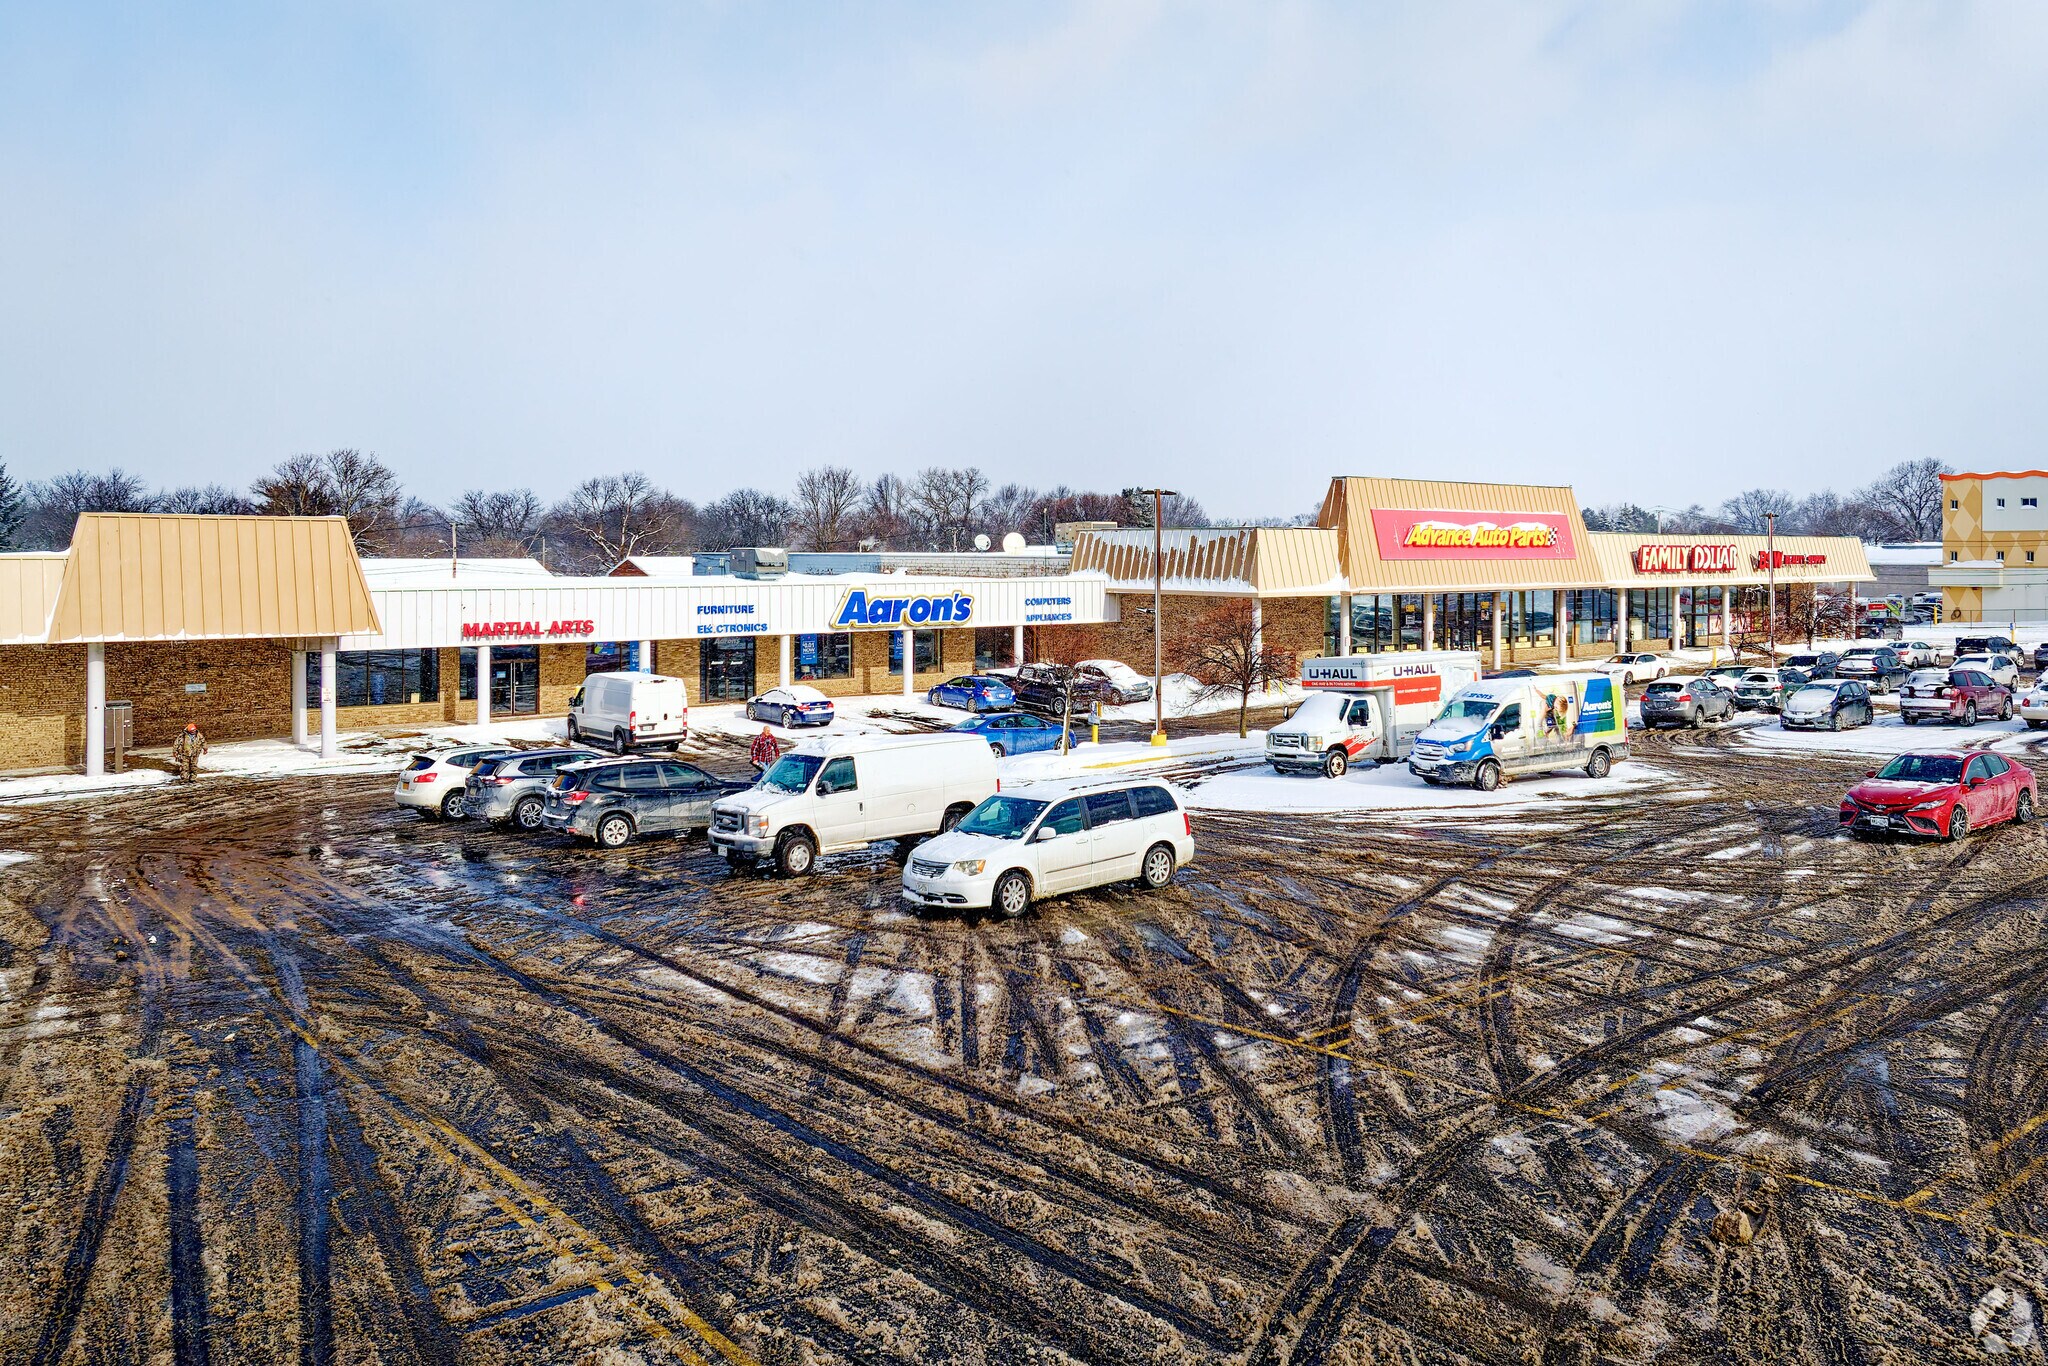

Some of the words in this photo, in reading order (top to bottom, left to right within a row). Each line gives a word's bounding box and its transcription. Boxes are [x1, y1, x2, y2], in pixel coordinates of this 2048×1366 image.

[1407, 524, 1471, 547] Advance
[1472, 525, 1510, 547] Auto
[1511, 526, 1545, 547] Parts
[1641, 545, 1690, 570] FAMILY
[1693, 545, 1738, 570] DOLLAR
[1025, 597, 1072, 606] COMPUTERS
[697, 605, 755, 615] FURNITURE
[836, 590, 973, 626] Aaron's
[1026, 613, 1073, 622] APPLIANCES
[463, 622, 545, 637] MARTIAL
[549, 620, 595, 635] ARTS
[1309, 669, 1357, 679] U-HAUL
[1393, 664, 1436, 677] U-HAUL
[1582, 700, 1612, 711] Aaron's
